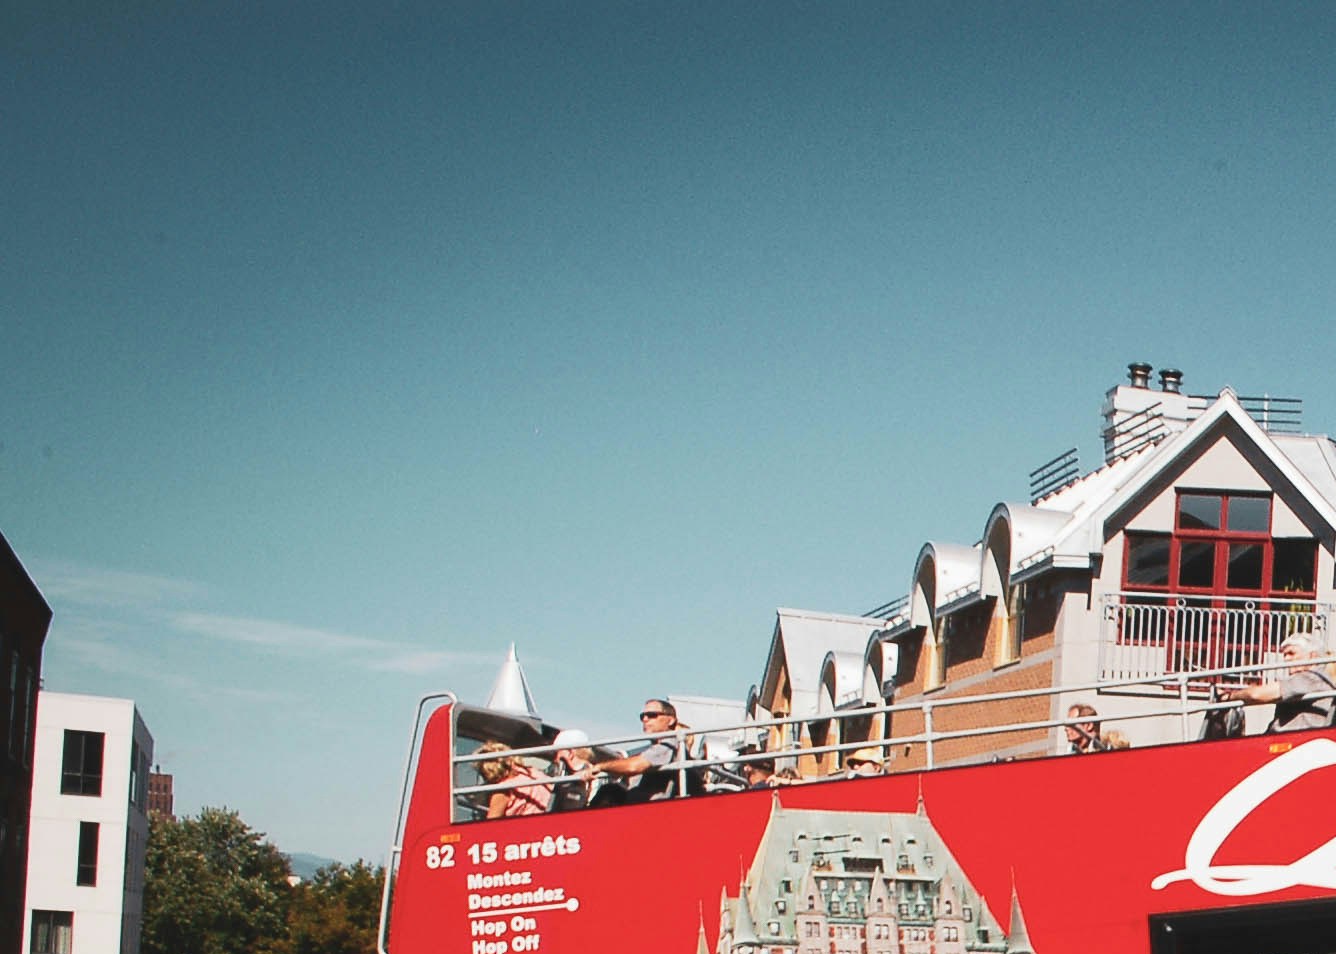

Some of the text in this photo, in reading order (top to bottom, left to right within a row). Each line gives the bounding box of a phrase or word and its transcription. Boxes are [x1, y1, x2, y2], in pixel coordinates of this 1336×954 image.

[426, 844, 455, 869] 82
[467, 835, 581, 864] 15 arrêts
[467, 871, 532, 890] Montez
[468, 887, 565, 910] Descendez
[471, 915, 537, 937] Hop On
[511, 934, 540, 951] Off
